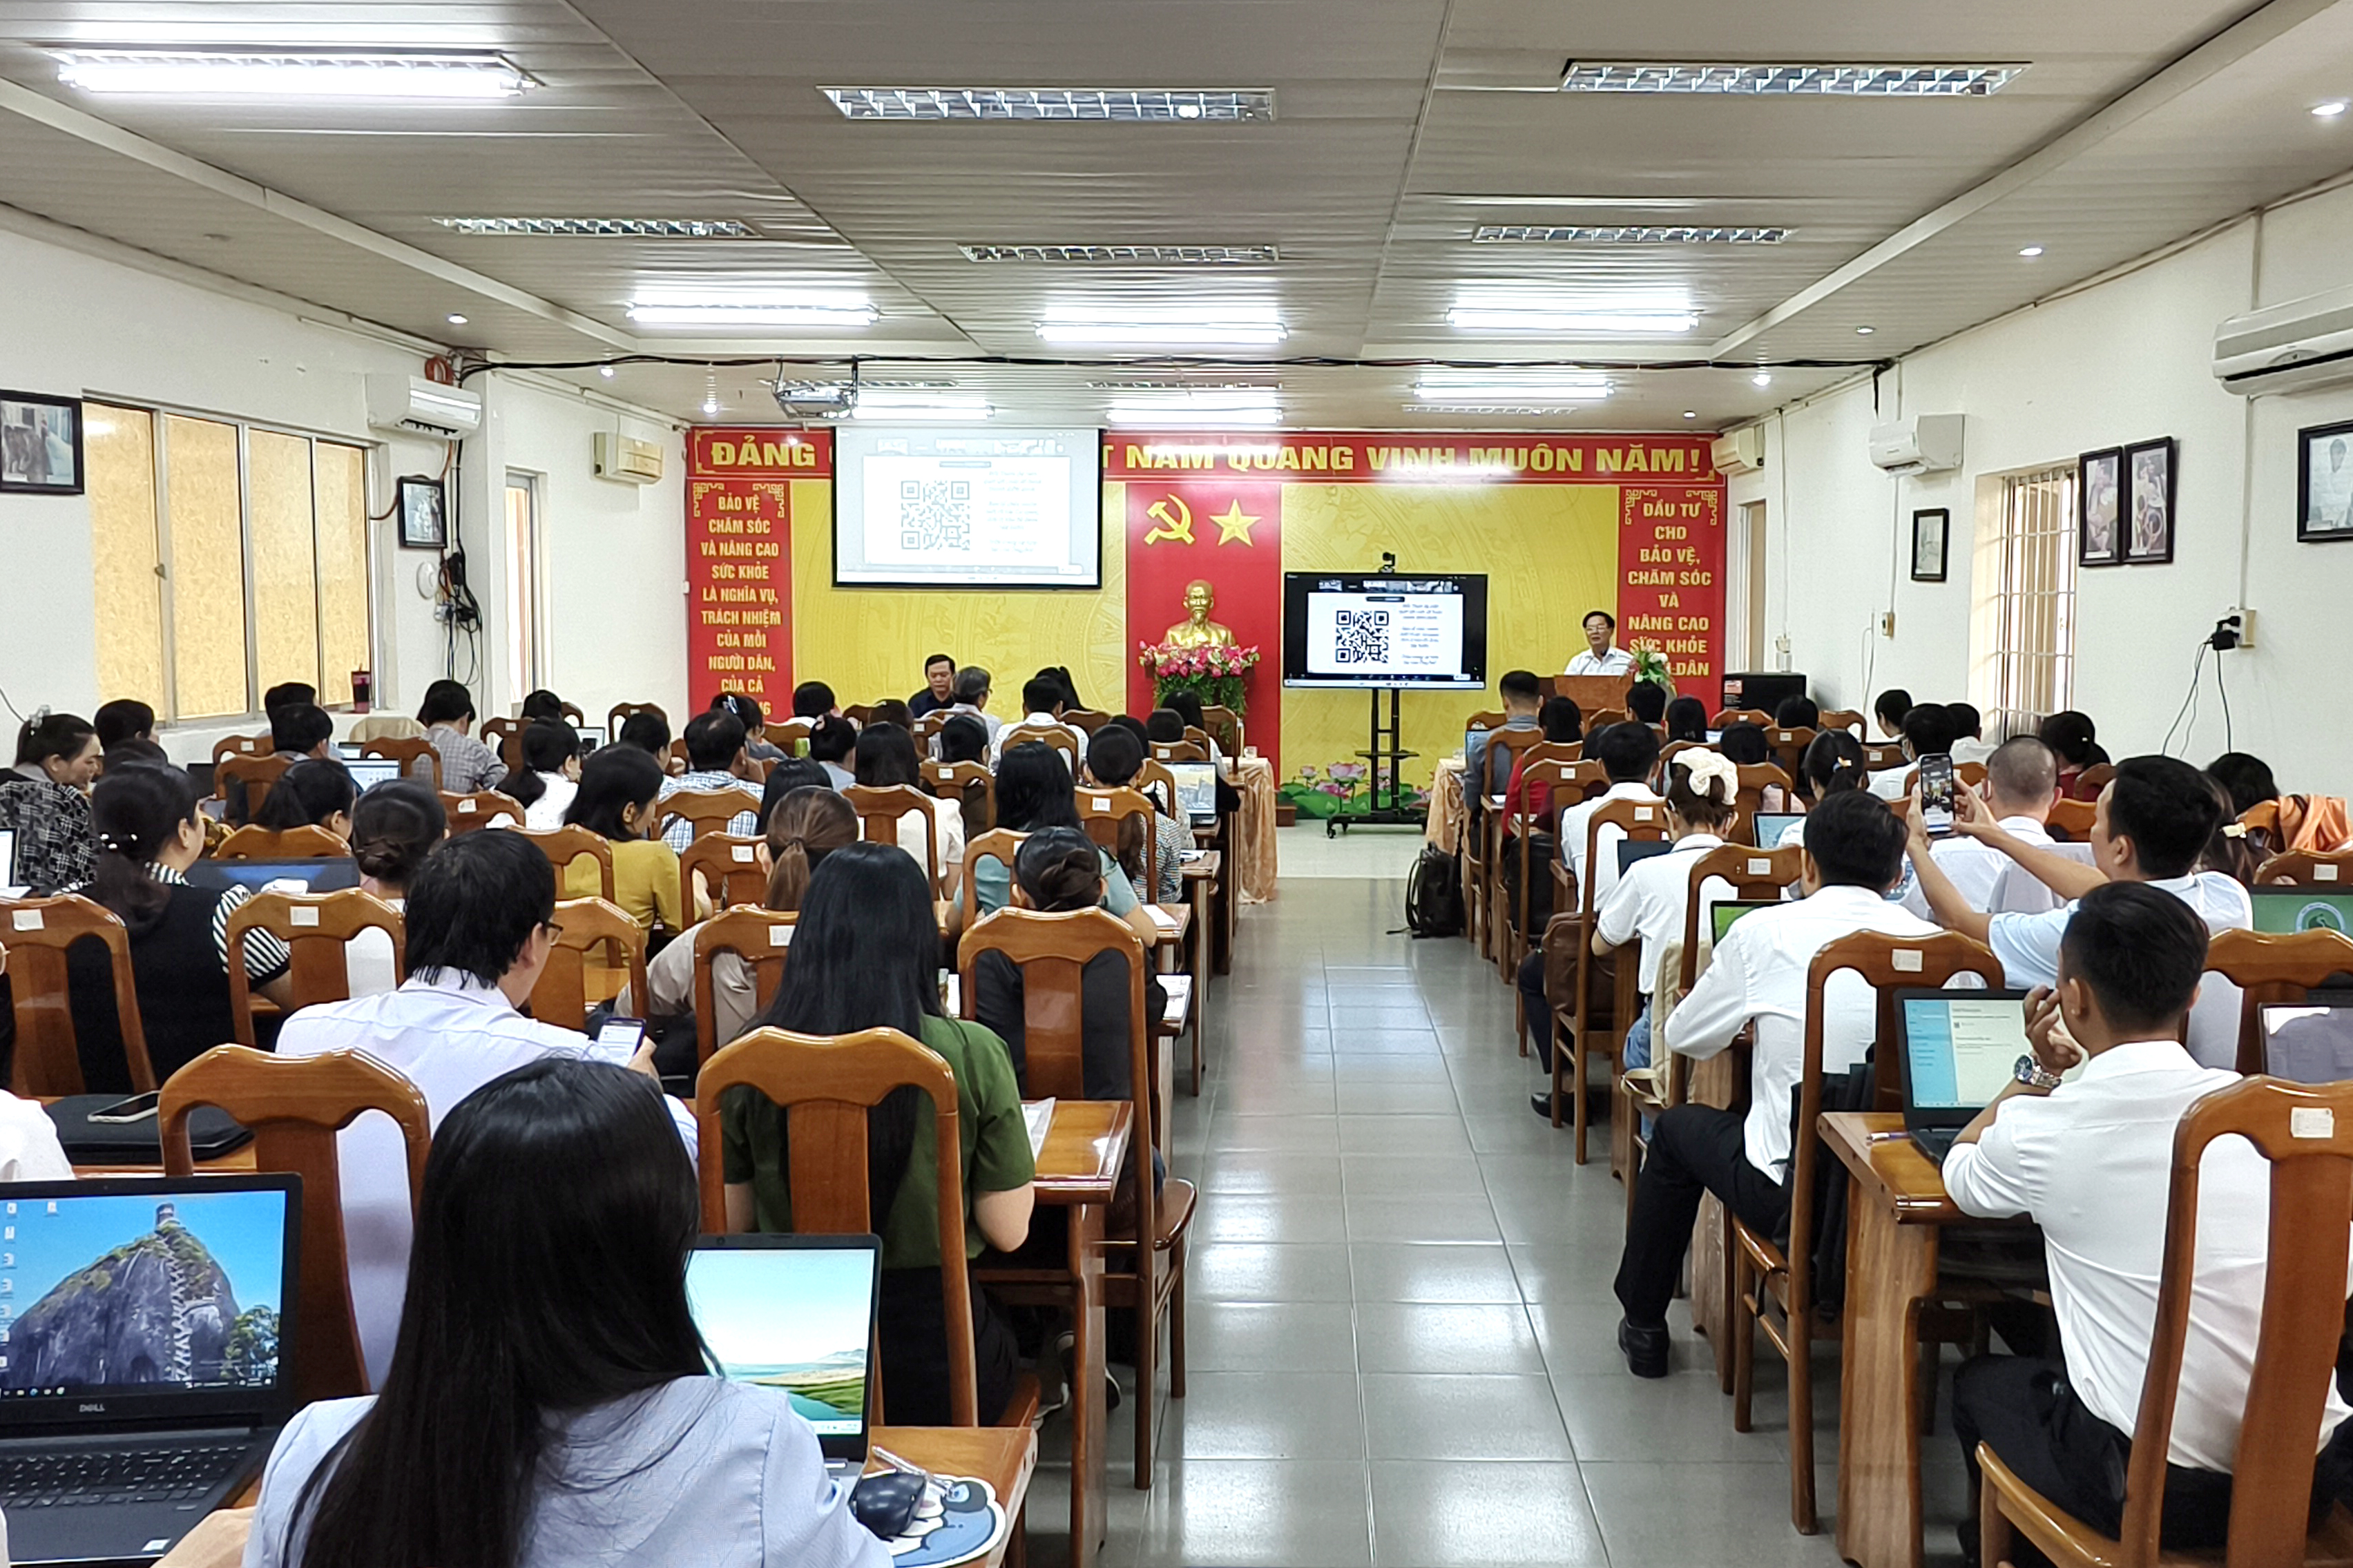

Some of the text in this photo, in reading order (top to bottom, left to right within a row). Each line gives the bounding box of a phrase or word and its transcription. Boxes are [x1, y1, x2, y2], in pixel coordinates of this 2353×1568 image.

[711, 435, 816, 466] ĐẢNG
[1126, 445, 1213, 469] NAM
[1227, 446, 1353, 472] QUANG
[1366, 446, 1455, 471] VINH
[1469, 443, 1582, 472] MUÔN
[718, 492, 760, 513] BẢO VỆ
[1680, 502, 1702, 517] TƯ
[708, 516, 770, 534] CHĂM SÓC
[1654, 525, 1687, 540] CHO
[700, 539, 778, 556] VÀ NÂNG CAO
[1640, 544, 1700, 566] BẢO VỆ,
[711, 561, 769, 579] SỨC KHỎE
[1628, 569, 1711, 585] CHĂM SÓC
[702, 585, 717, 602] LÀ
[720, 585, 756, 602] NGHĨA
[1658, 592, 1679, 608] VÀ
[701, 608, 781, 628] TRÁCH NHIỆM
[1628, 613, 1709, 630] NÂNG CAO
[717, 629, 740, 647] CỦA
[1666, 635, 1707, 653] KHỎE
[708, 652, 745, 670] NGƯỜI
[721, 674, 764, 693] CỦA CẢ
